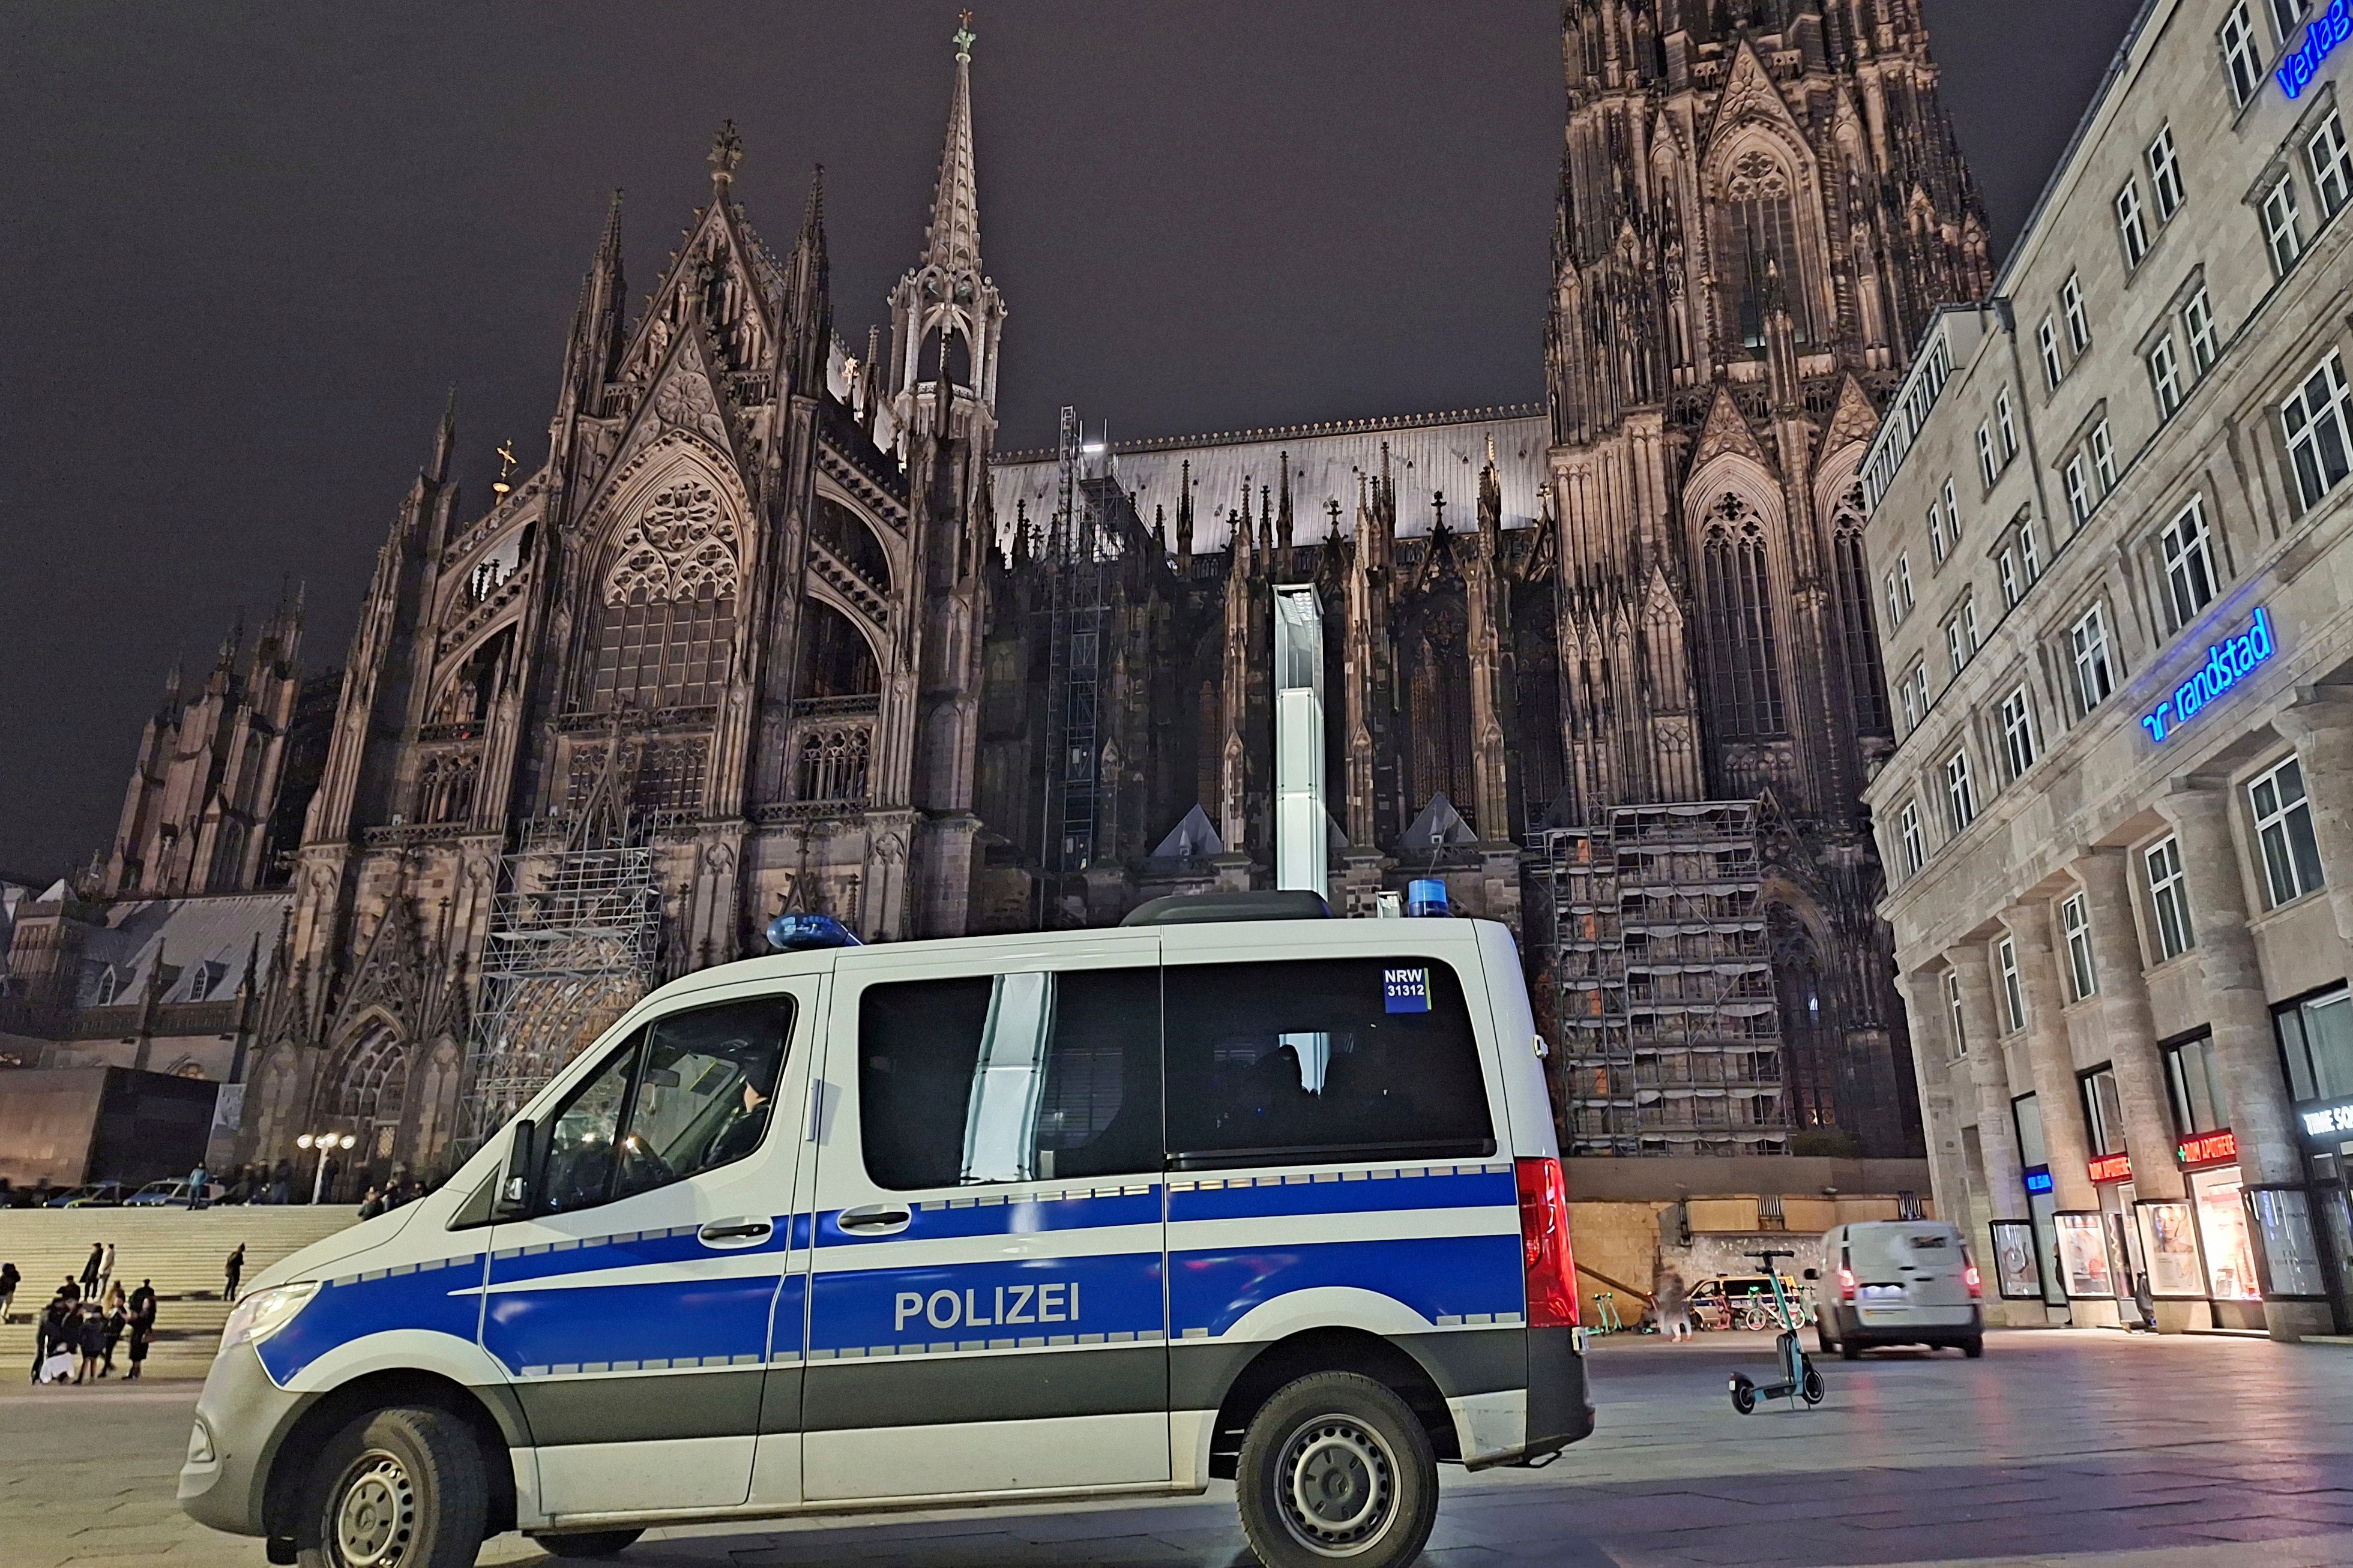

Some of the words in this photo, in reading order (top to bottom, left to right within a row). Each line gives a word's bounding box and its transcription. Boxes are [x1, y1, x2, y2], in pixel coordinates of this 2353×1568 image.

[2277, 0, 2352, 98] Verlag
[2173, 605, 2273, 722] randstad
[1384, 969, 1422, 983] NRW
[1387, 984, 1425, 997] 31312
[894, 1282, 1079, 1332] POLIZEI
